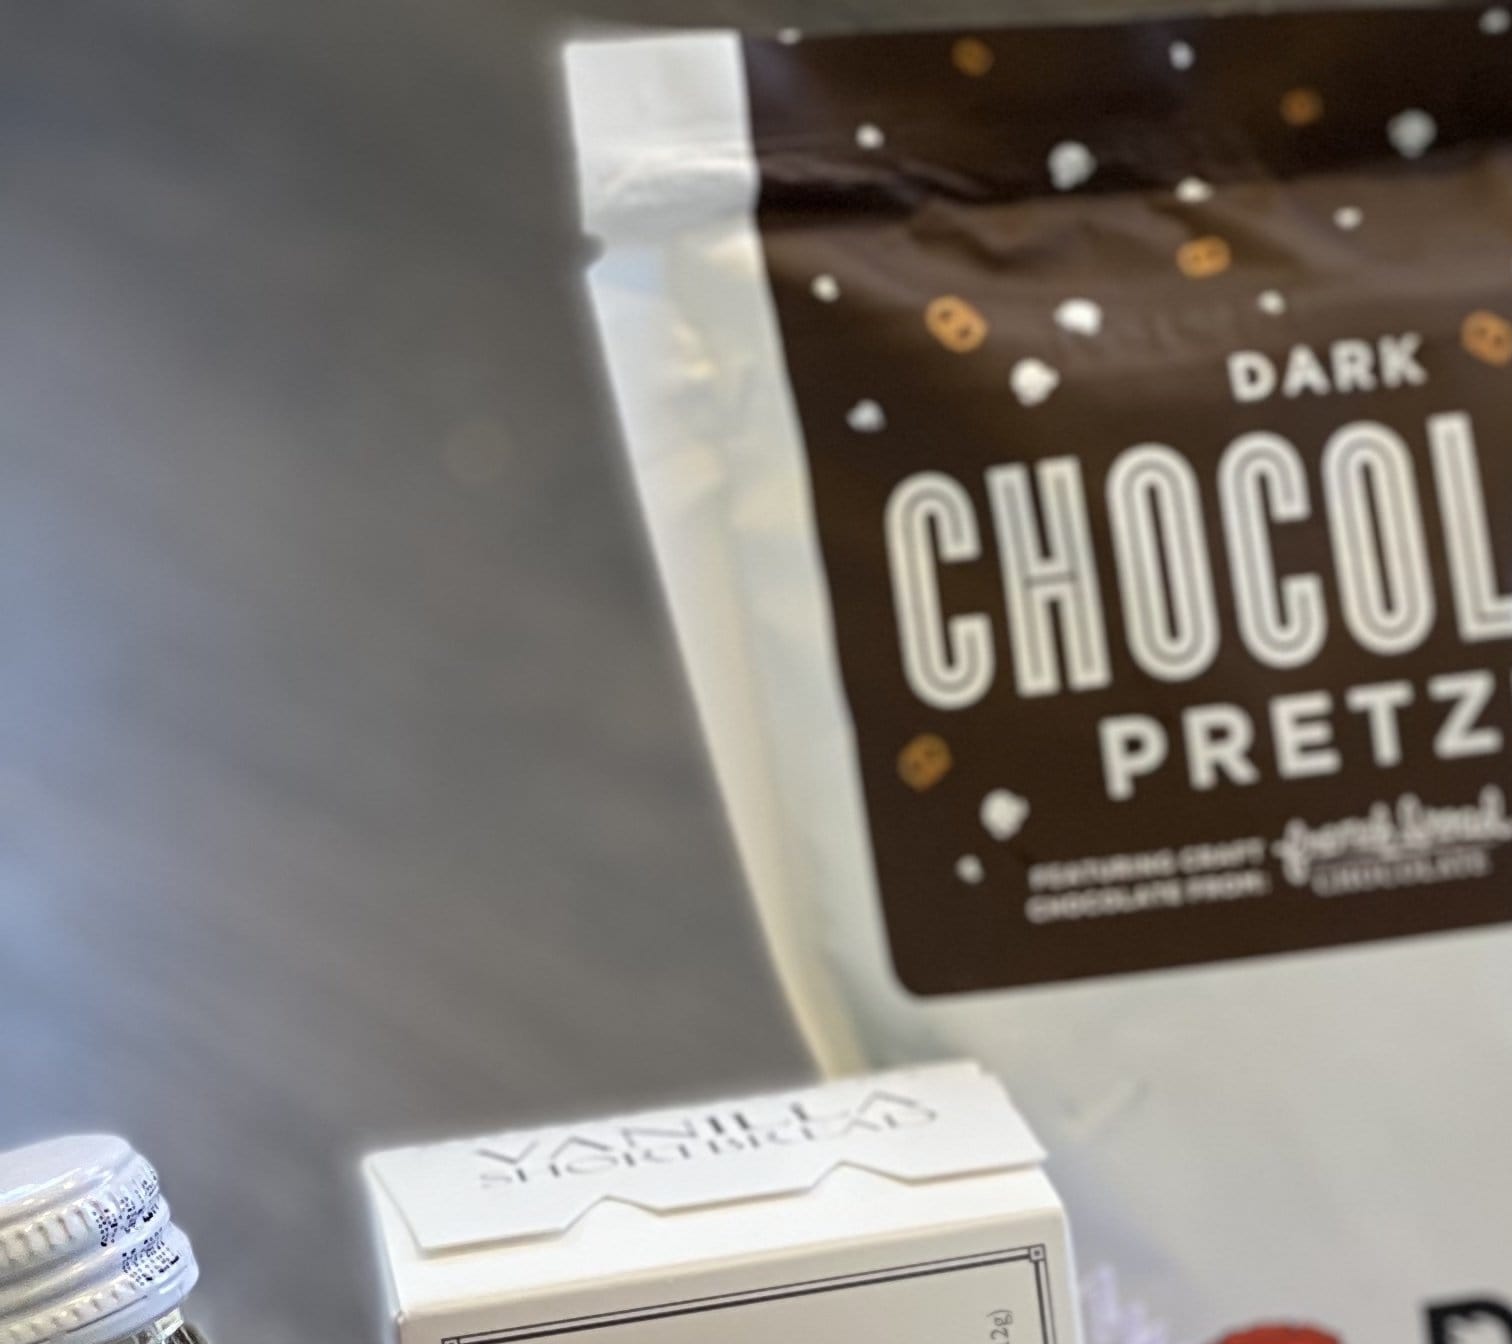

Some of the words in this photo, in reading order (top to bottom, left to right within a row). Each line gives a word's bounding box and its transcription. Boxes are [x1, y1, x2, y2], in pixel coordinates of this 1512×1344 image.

[1227, 336, 1425, 402] DARK
[476, 1090, 918, 1166] VANILLA
[480, 1109, 937, 1187] SHORTBREAD
